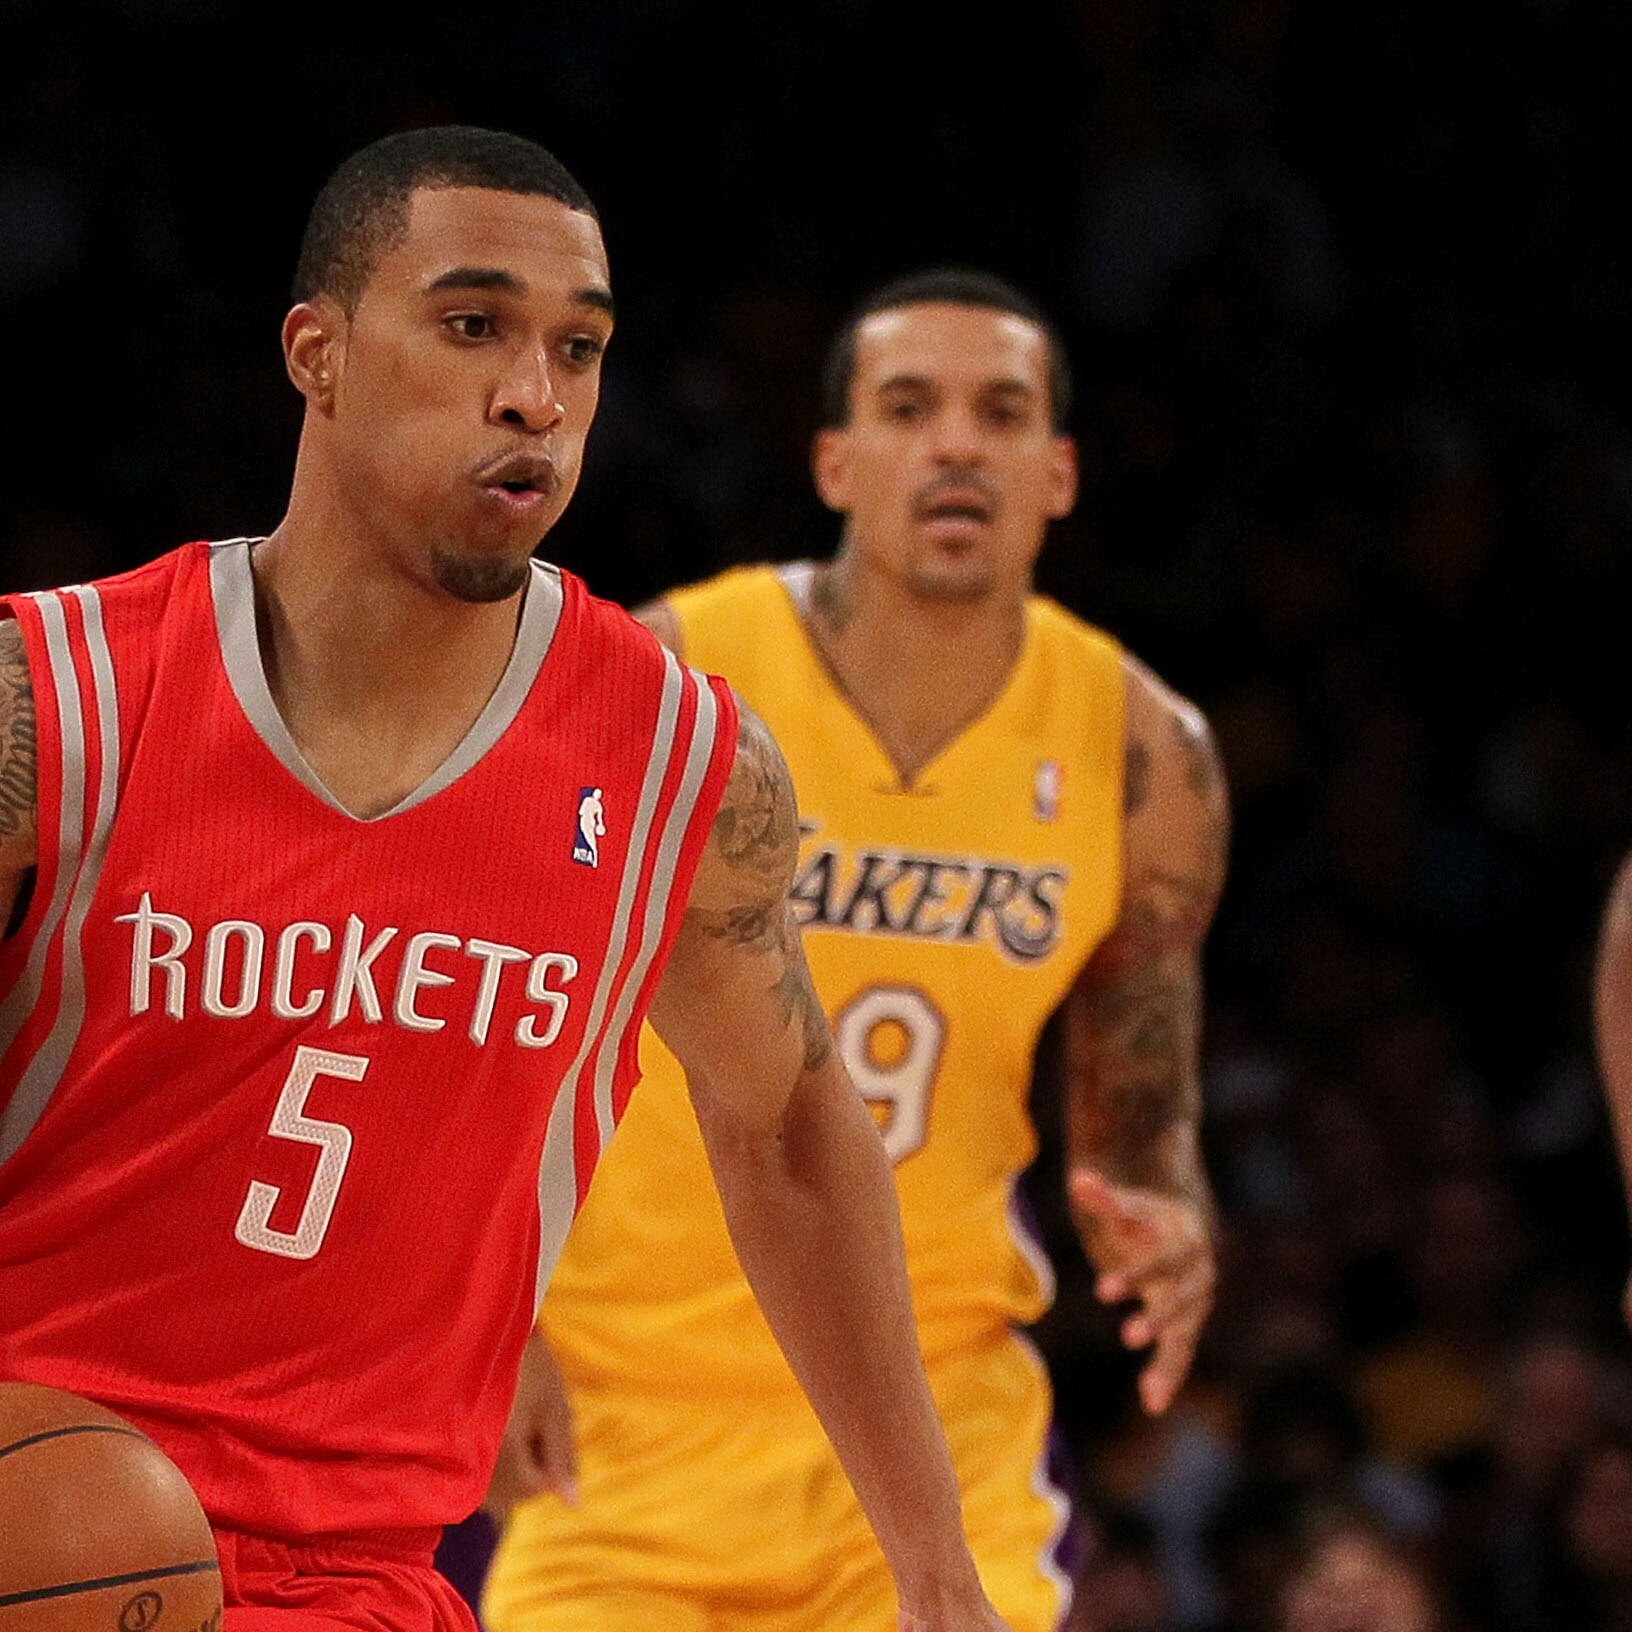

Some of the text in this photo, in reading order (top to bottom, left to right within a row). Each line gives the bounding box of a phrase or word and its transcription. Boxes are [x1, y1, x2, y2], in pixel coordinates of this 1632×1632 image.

[114, 890, 580, 1050] ROCKETS
[789, 822, 1067, 962] AKERS
[234, 1044, 370, 1261] 5
[839, 982, 945, 1167] 9
